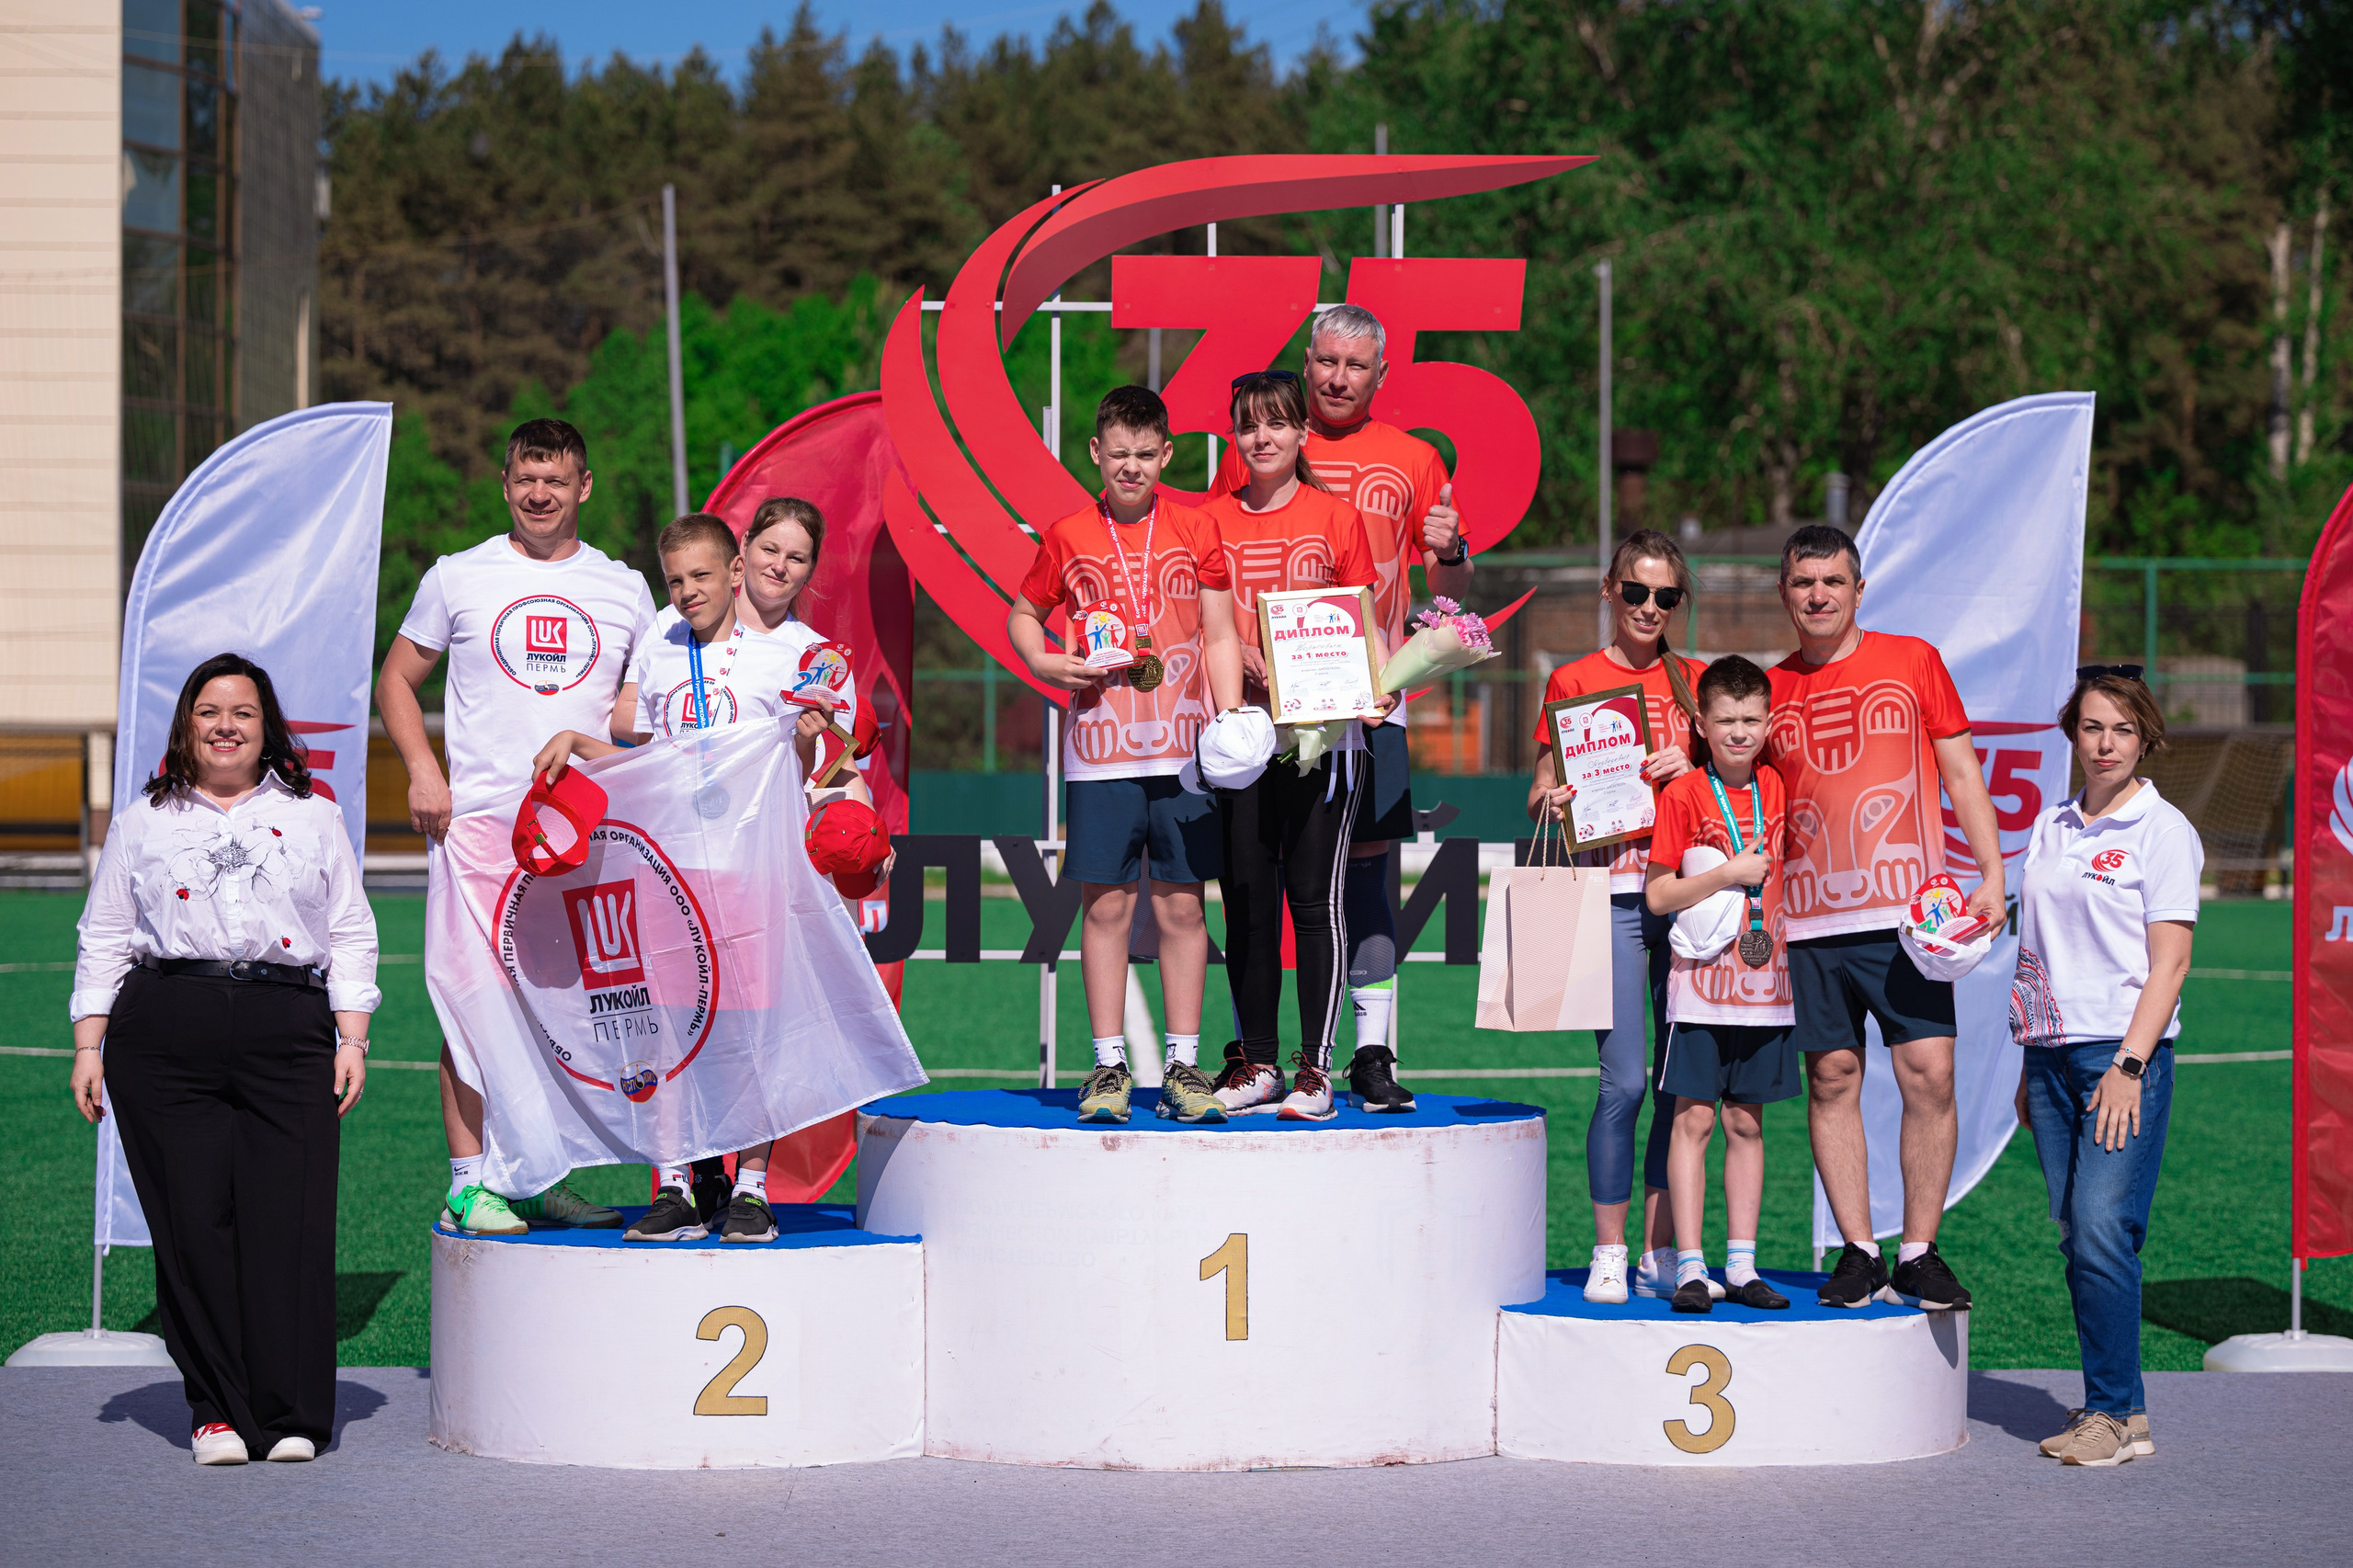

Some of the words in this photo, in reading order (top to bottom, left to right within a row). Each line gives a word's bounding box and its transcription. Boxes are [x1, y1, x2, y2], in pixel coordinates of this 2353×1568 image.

[511, 597, 556, 612] ПРОФСОЮЗНАЯ
[555, 599, 590, 625] ОРГАНИЗАЦИЯ
[1274, 625, 1350, 642] ДИПЛОМ
[526, 653, 567, 663] ЛУКОЙЛ
[526, 663, 567, 674] ПЕРМЬ
[1315, 651, 1347, 659] место
[792, 672, 813, 691] 2
[1564, 733, 1631, 759] ДИПЛОМ
[1602, 763, 1631, 775] место
[2101, 852, 2125, 869] 35
[503, 885, 529, 962] ПЕРВИЧНАЯ
[609, 830, 673, 885] ОРГАНИЗАЦИЯ
[669, 885, 690, 916] ООО
[686, 919, 710, 1037] «ЛУКОЙЛ-ПЕРМЬ»
[588, 983, 652, 1015] ЛУКОЙЛ
[593, 1015, 659, 1043] ПЕРМЬ
[1199, 1233, 1248, 1342] 1
[693, 1305, 768, 1416] 2
[1663, 1344, 1736, 1454] 3
